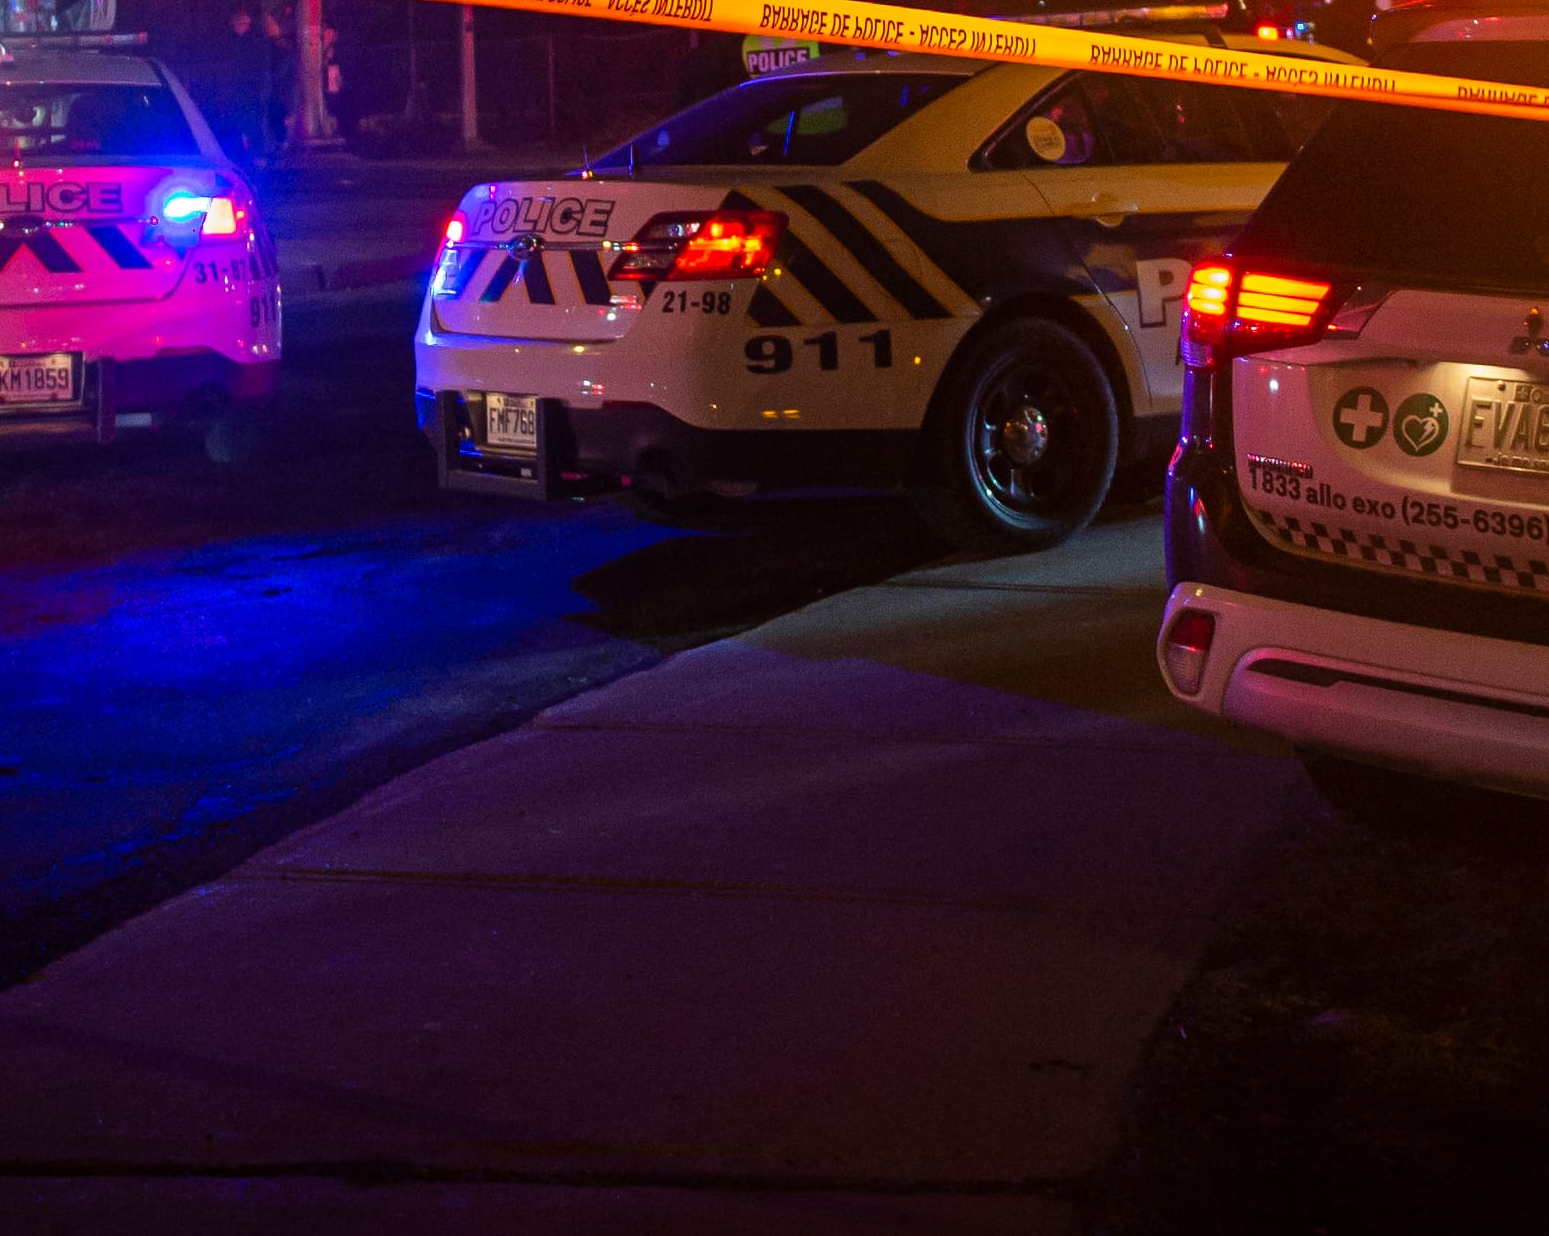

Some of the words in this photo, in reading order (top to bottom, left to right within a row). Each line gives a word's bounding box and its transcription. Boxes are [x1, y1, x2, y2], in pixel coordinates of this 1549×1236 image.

[472, 197, 616, 238] POLICE
[662, 290, 732, 314] 21-98
[744, 329, 893, 375] 911
[1262, 471, 1301, 501] 833
[1306, 483, 1347, 510] allo
[1352, 495, 1396, 520] exo
